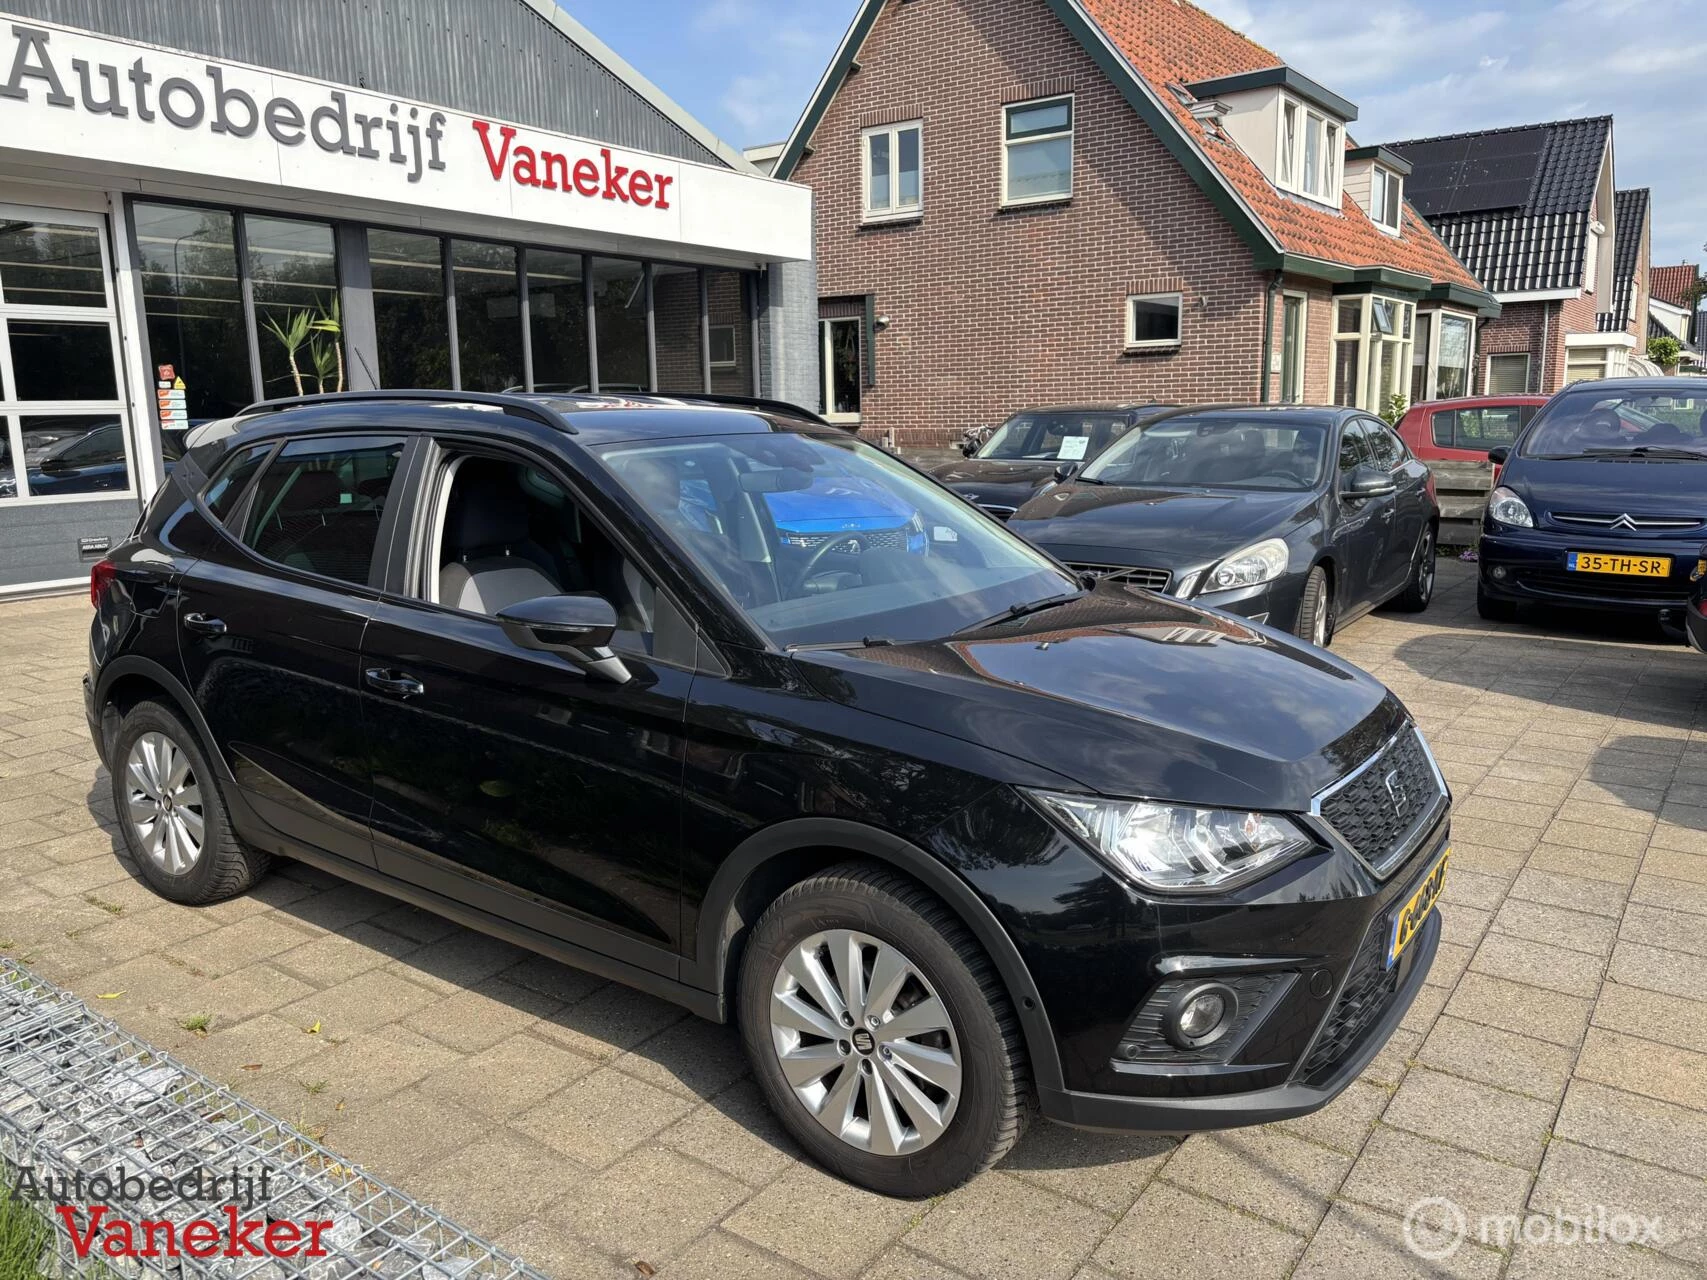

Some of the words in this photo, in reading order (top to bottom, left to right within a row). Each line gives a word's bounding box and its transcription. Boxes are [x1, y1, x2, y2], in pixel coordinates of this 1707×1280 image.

[1, 25, 447, 183] Autobedrijf
[472, 120, 674, 211] Vaneker
[1580, 556, 1661, 574] 35-TH-SR
